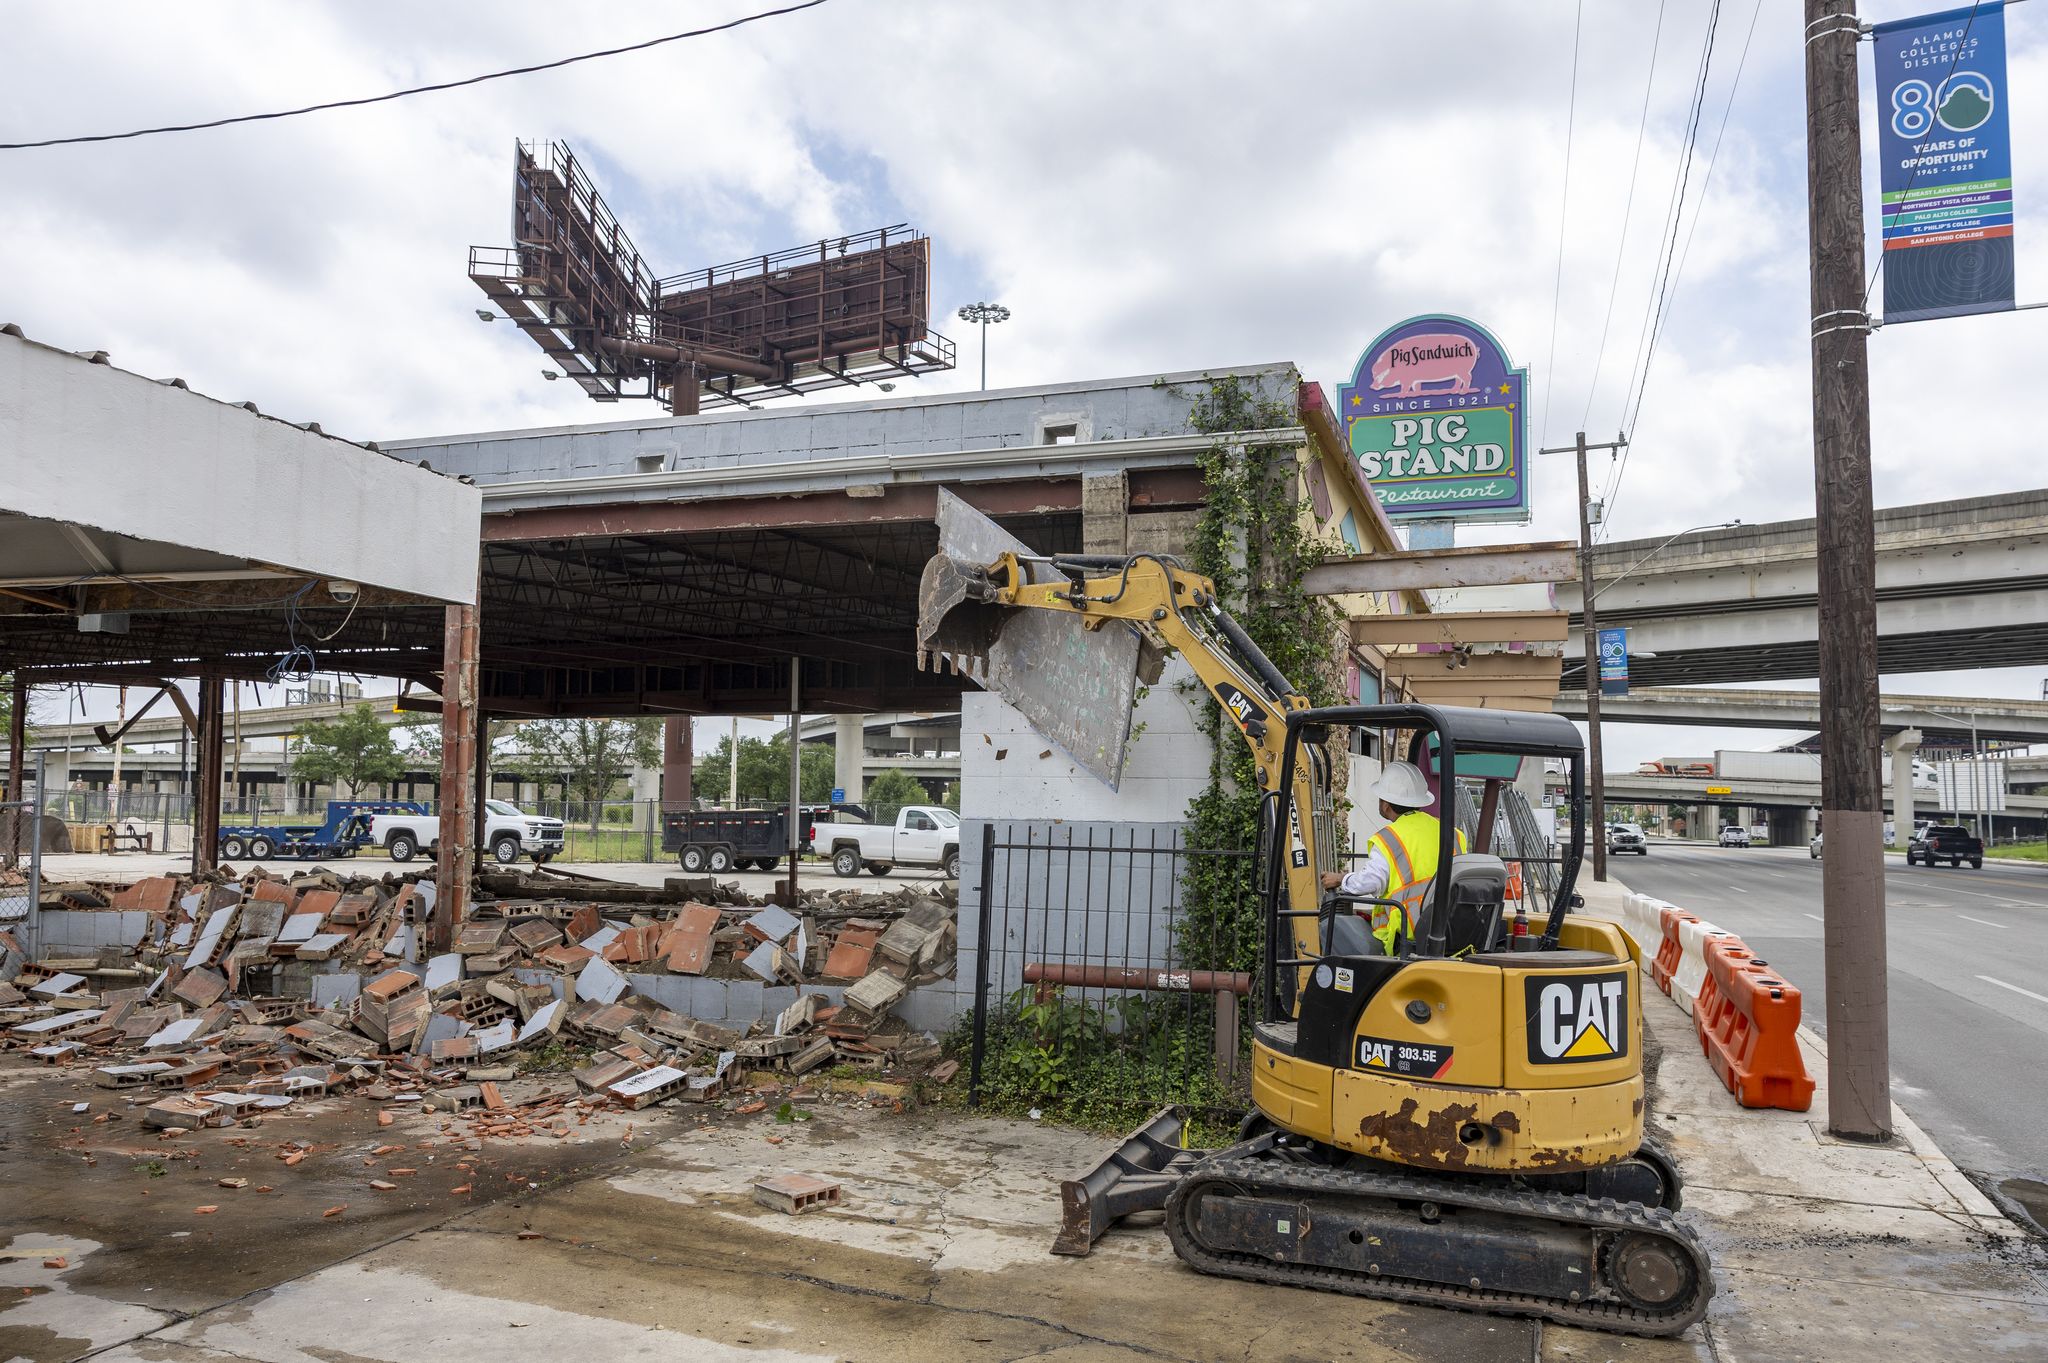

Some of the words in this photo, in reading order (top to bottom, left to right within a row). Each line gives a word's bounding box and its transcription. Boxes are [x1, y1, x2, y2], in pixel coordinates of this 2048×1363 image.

[1912, 29, 1964, 46] ALAMO
[1900, 38, 1978, 58] COLLEGES
[1905, 50, 1975, 68] DISTRICT
[1891, 71, 1994, 139] 80
[1913, 140, 1955, 153] YEARS
[1959, 138, 1976, 148] OF
[1901, 149, 1988, 168] OPPORTUNITY
[1951, 164, 1974, 172] 2025
[1934, 186, 1966, 195] LAKEVIEW
[1902, 201, 1940, 210] NORTHWEST
[1962, 195, 1990, 203] COLLEGE
[1924, 223, 1951, 231] PHILIP'S
[1391, 348, 1410, 367] Pig
[1412, 343, 1473, 365] Sandwich
[1373, 401, 1431, 412] SINCE
[1448, 396, 1489, 406] 1921
[1392, 415, 1469, 447] PIG
[1358, 443, 1505, 479] STAND
[1228, 691, 1252, 720] CAT
[1295, 851, 1305, 866] CAT
[1540, 980, 1622, 1058] CAT
[1361, 1041, 1393, 1068] CAT
[1399, 1046, 1436, 1062] 303.5E
